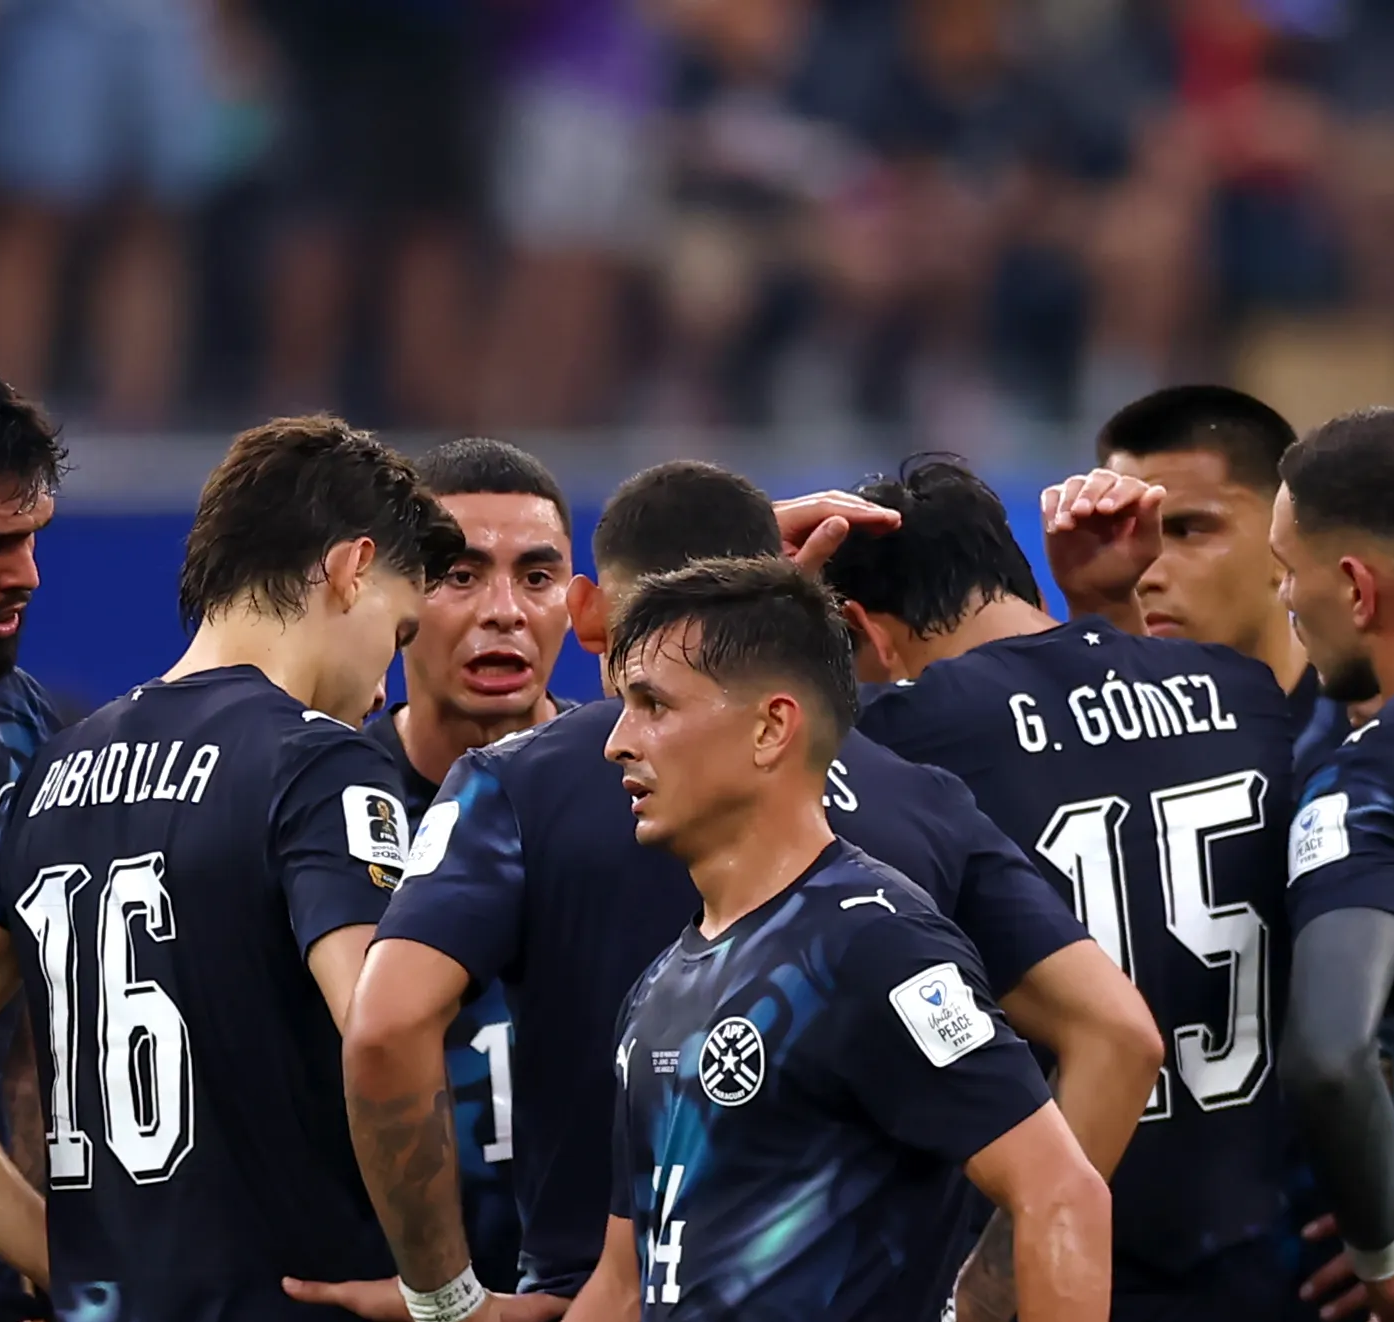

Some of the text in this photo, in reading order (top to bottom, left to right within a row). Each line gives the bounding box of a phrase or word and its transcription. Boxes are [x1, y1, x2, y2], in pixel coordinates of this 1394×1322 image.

[1009, 669, 1238, 753] G. GÓMEZ
[1036, 769, 1270, 1121] 15
[16, 851, 196, 1190] 16
[722, 1024, 746, 1039] APF
[937, 1013, 974, 1042] PEACE
[953, 1032, 973, 1047] FIFA
[712, 1087, 746, 1100] PARAGUAY
